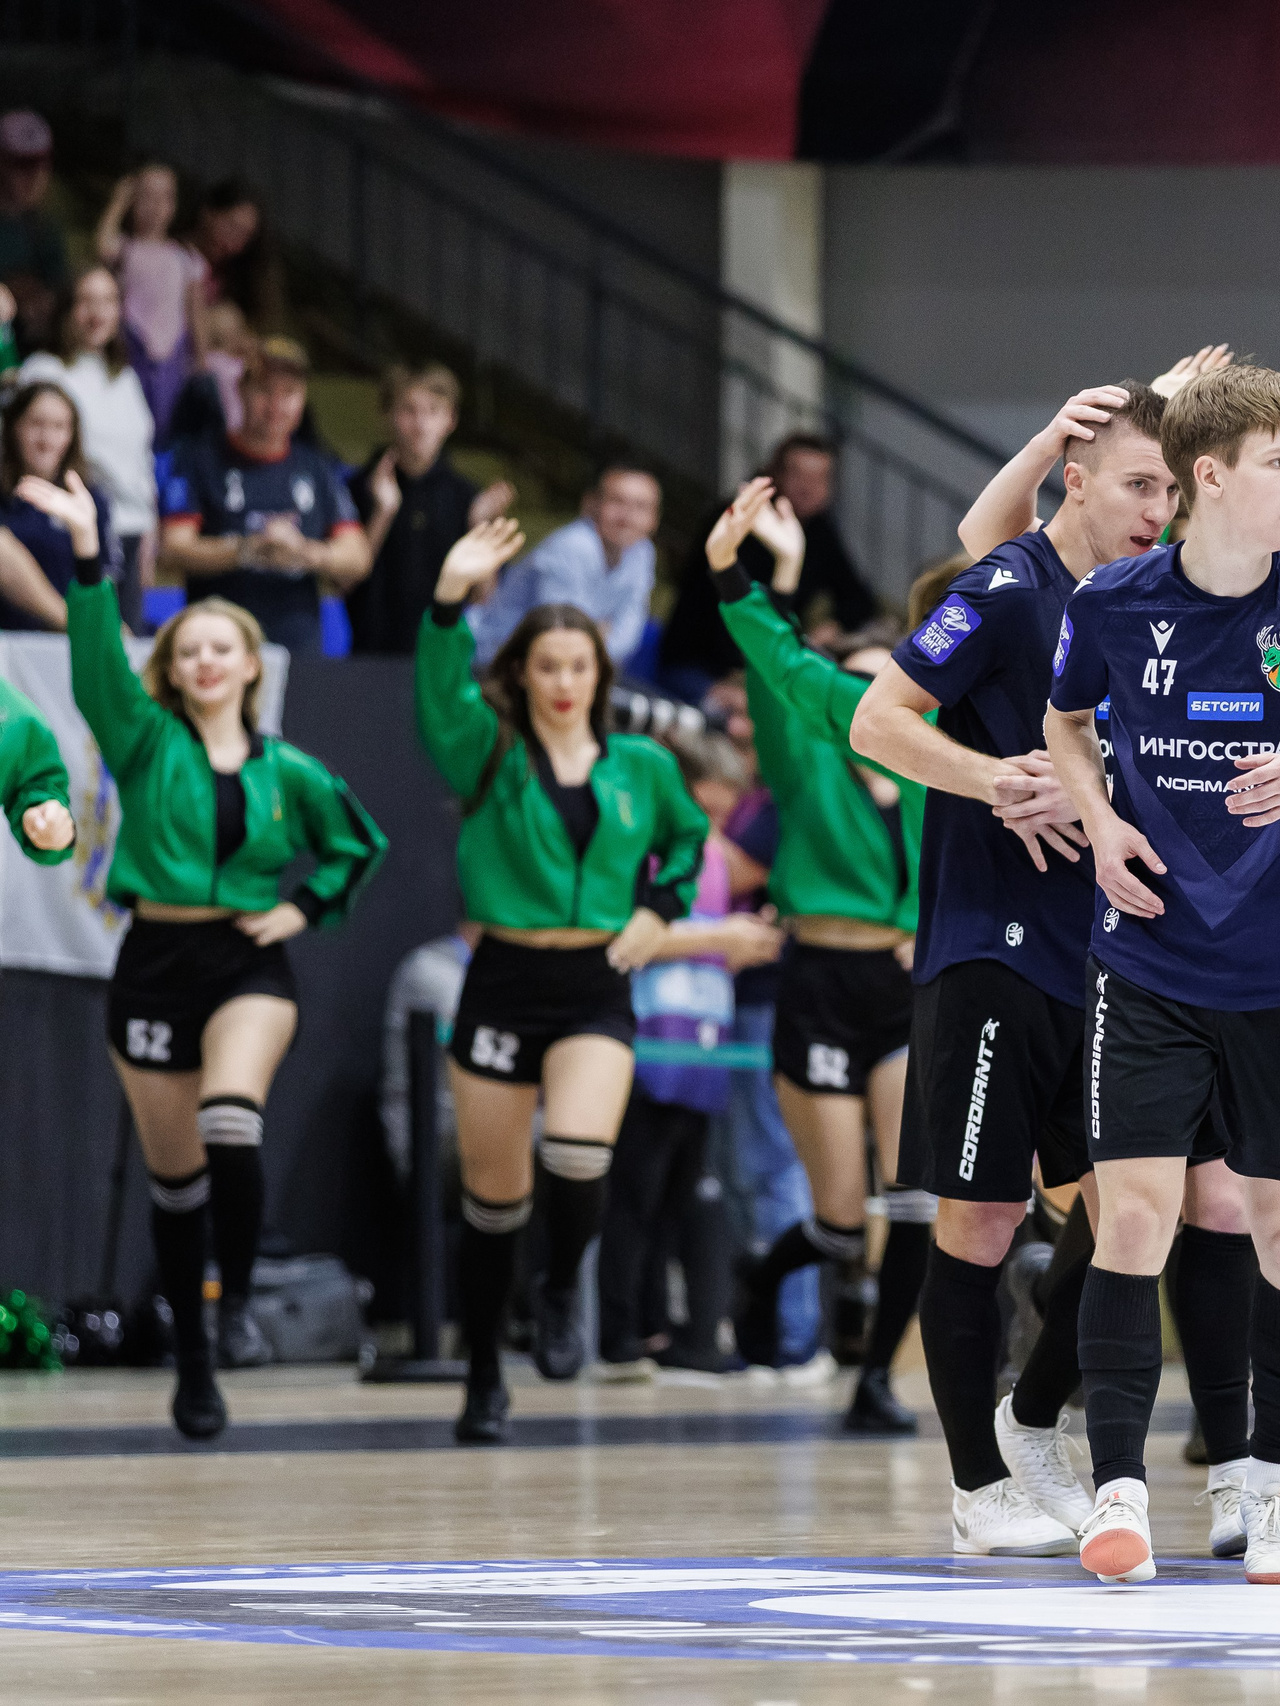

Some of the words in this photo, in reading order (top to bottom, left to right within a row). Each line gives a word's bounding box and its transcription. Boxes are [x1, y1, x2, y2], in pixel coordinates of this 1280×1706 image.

[920, 634, 942, 655] ЛИГА
[925, 626, 950, 650] СУПЕР
[1141, 658, 1178, 696] 47
[1190, 700, 1261, 713] БЕТСИТИ
[126, 1018, 173, 1061] 52
[470, 1025, 520, 1073] 52
[1091, 996, 1109, 1140] CORDIANT
[958, 1039, 998, 1182] CORDIANT
